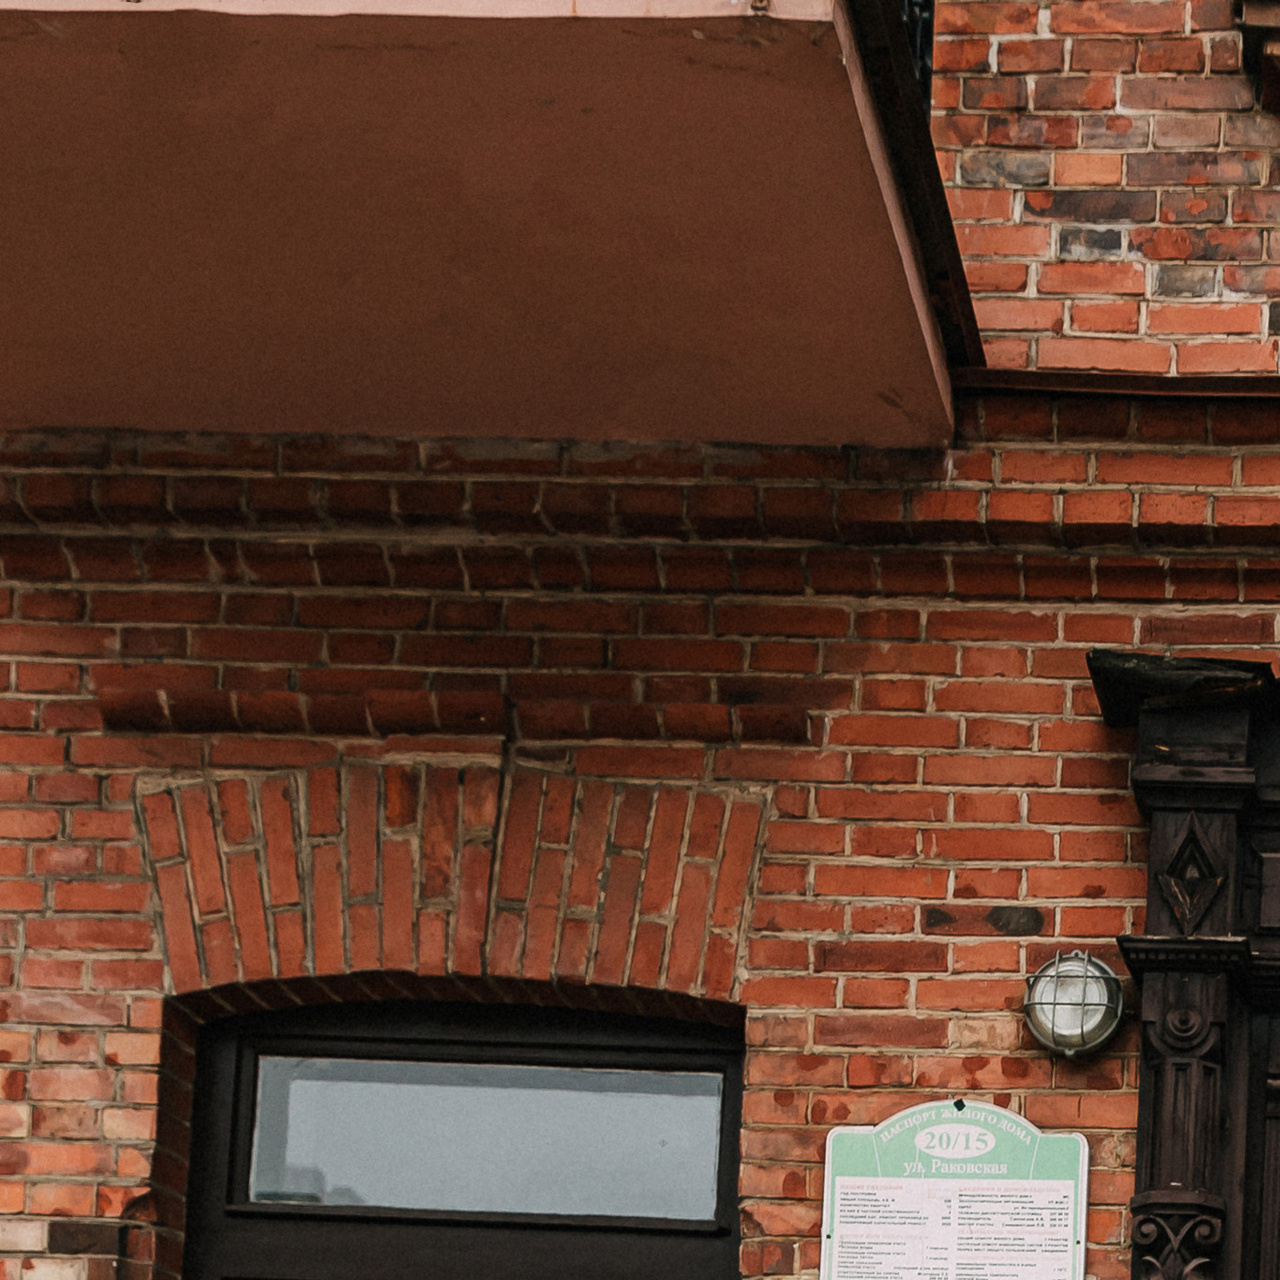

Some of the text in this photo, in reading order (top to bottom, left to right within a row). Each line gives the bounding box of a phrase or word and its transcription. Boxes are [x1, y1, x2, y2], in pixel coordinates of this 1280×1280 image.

[880, 1109, 937, 1143] ПАСПОРТ
[997, 1117, 1033, 1146] ДОМА
[924, 1131, 989, 1151] 20/15
[931, 1159, 1008, 1175] Раковская
